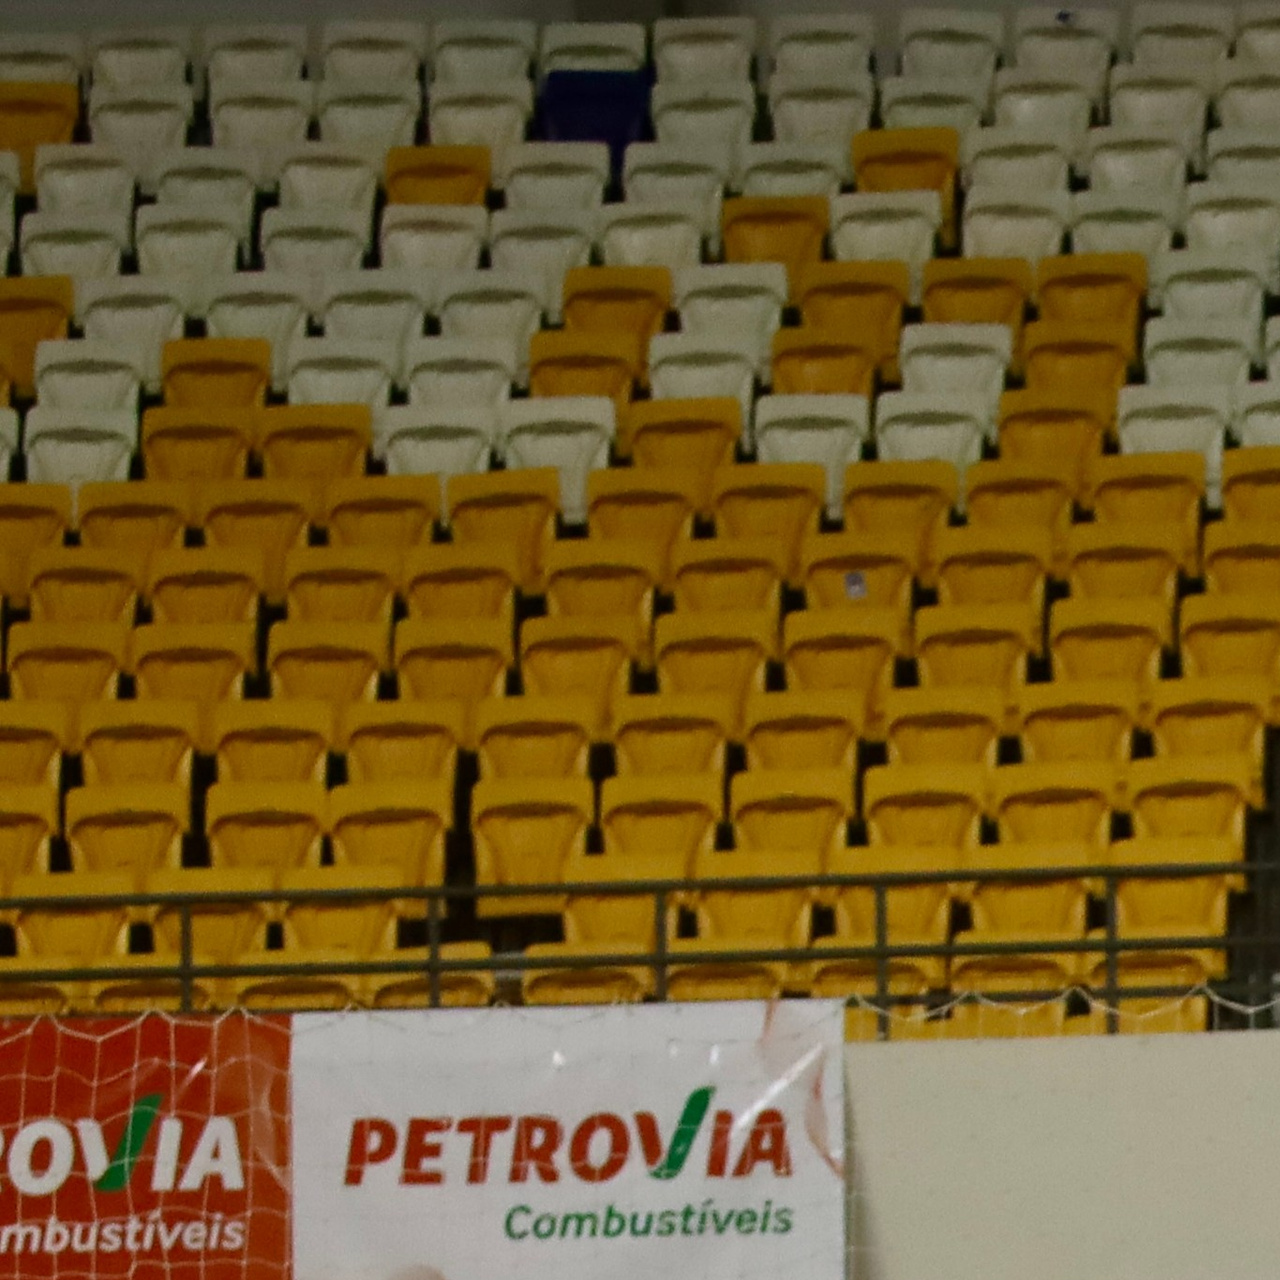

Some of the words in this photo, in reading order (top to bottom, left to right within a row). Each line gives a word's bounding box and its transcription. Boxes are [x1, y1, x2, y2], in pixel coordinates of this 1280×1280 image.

[0, 1094, 244, 1196] OVIA
[344, 1086, 793, 1186] PETROVIA
[504, 1199, 794, 1240] Combustíveis
